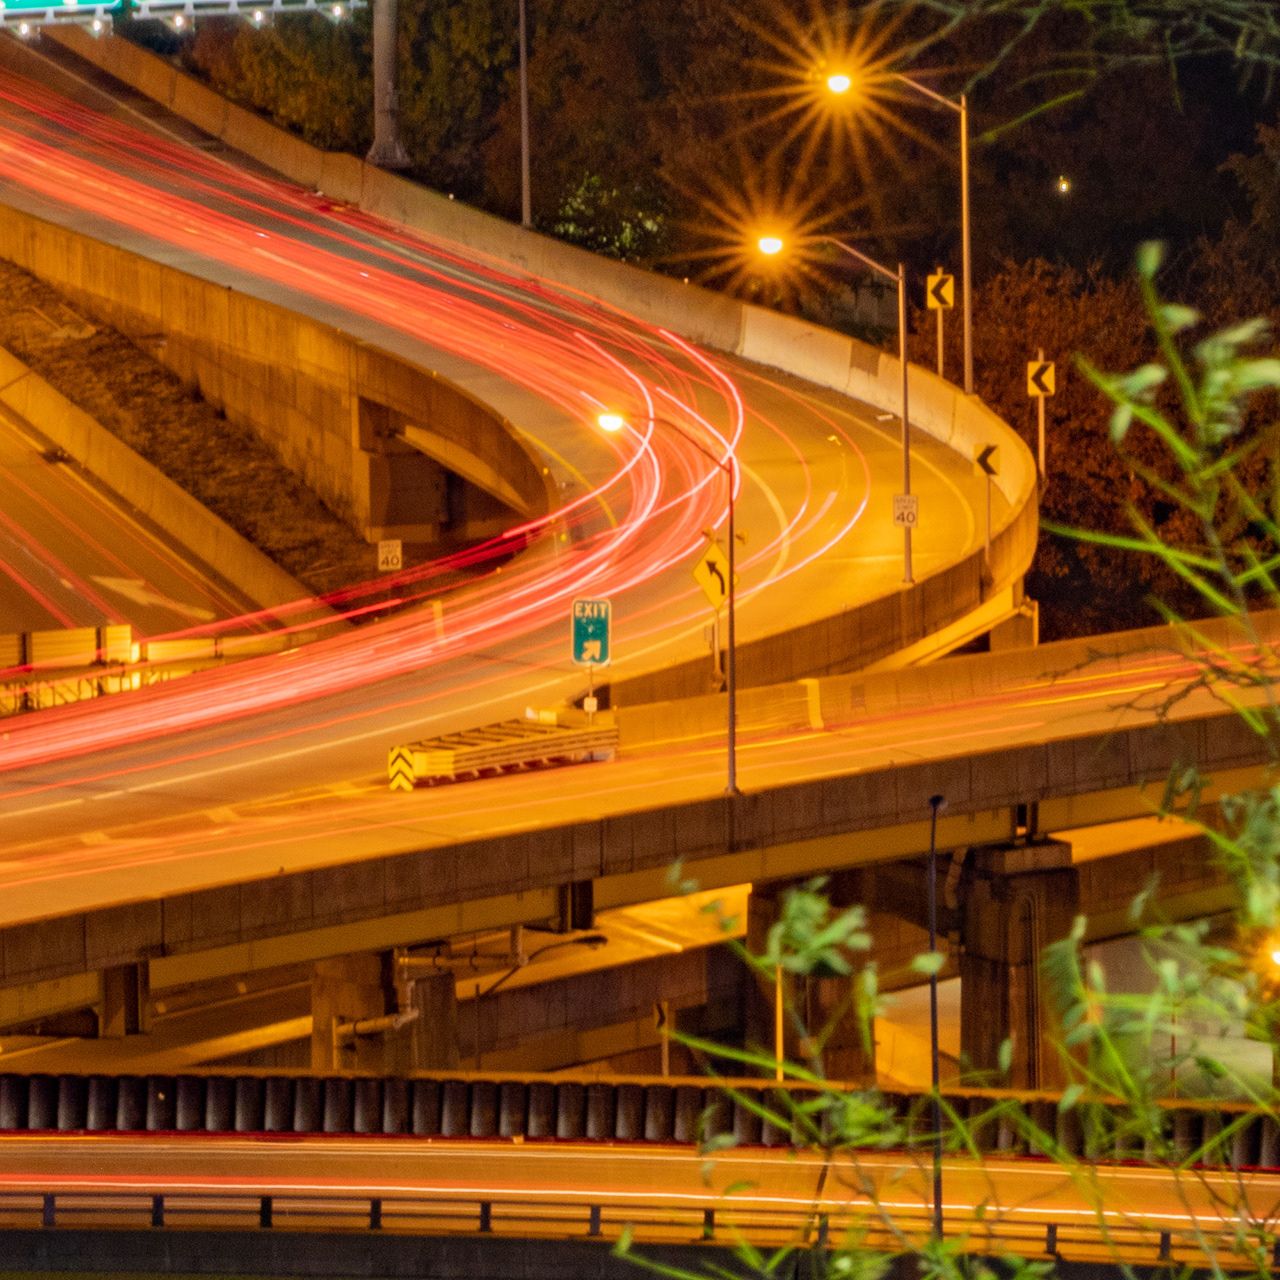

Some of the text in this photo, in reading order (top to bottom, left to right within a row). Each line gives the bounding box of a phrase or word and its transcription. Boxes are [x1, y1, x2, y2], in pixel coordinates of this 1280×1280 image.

[896, 511, 915, 523] 40
[381, 554, 399, 567] 40
[575, 603, 607, 618] EXIT
